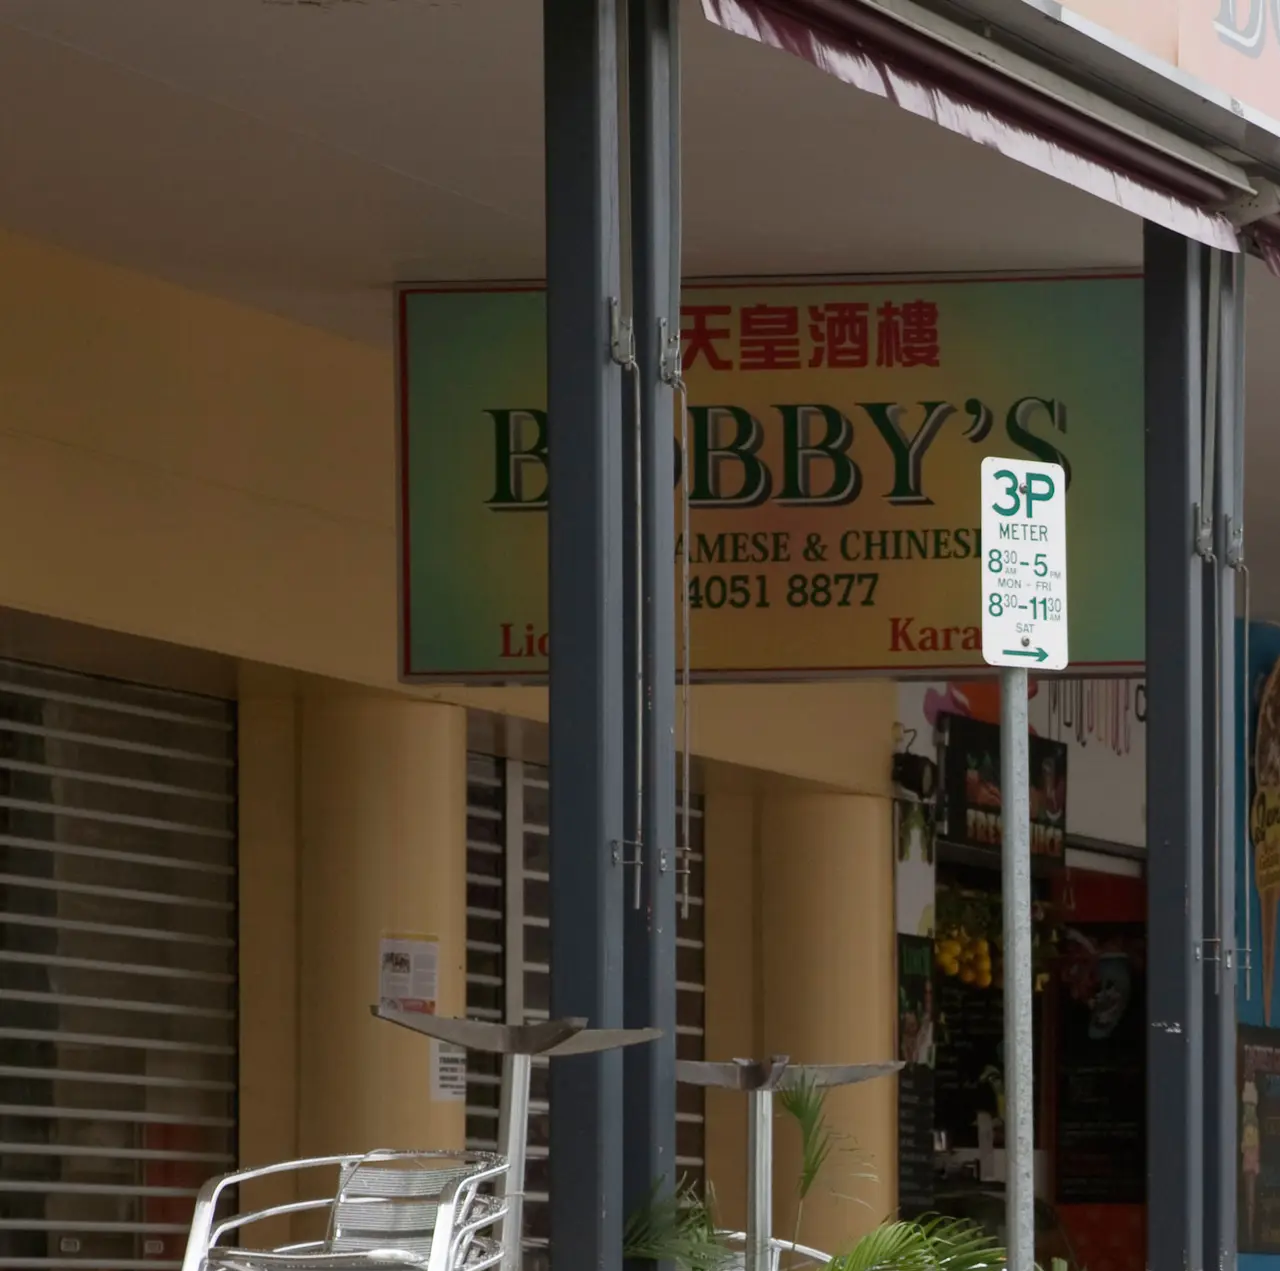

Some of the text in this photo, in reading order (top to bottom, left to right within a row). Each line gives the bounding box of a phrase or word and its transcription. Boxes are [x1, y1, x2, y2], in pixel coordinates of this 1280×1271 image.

[484, 395, 1072, 511] BBBY'S
[992, 469, 1055, 518] 3P
[802, 532, 828, 562] &
[999, 523, 1048, 541] METER
[682, 572, 879, 609] 4051 8877
[998, 577, 1022, 589] MON
[1035, 581, 1052, 592] FRI
[1016, 622, 1035, 633] SAT
